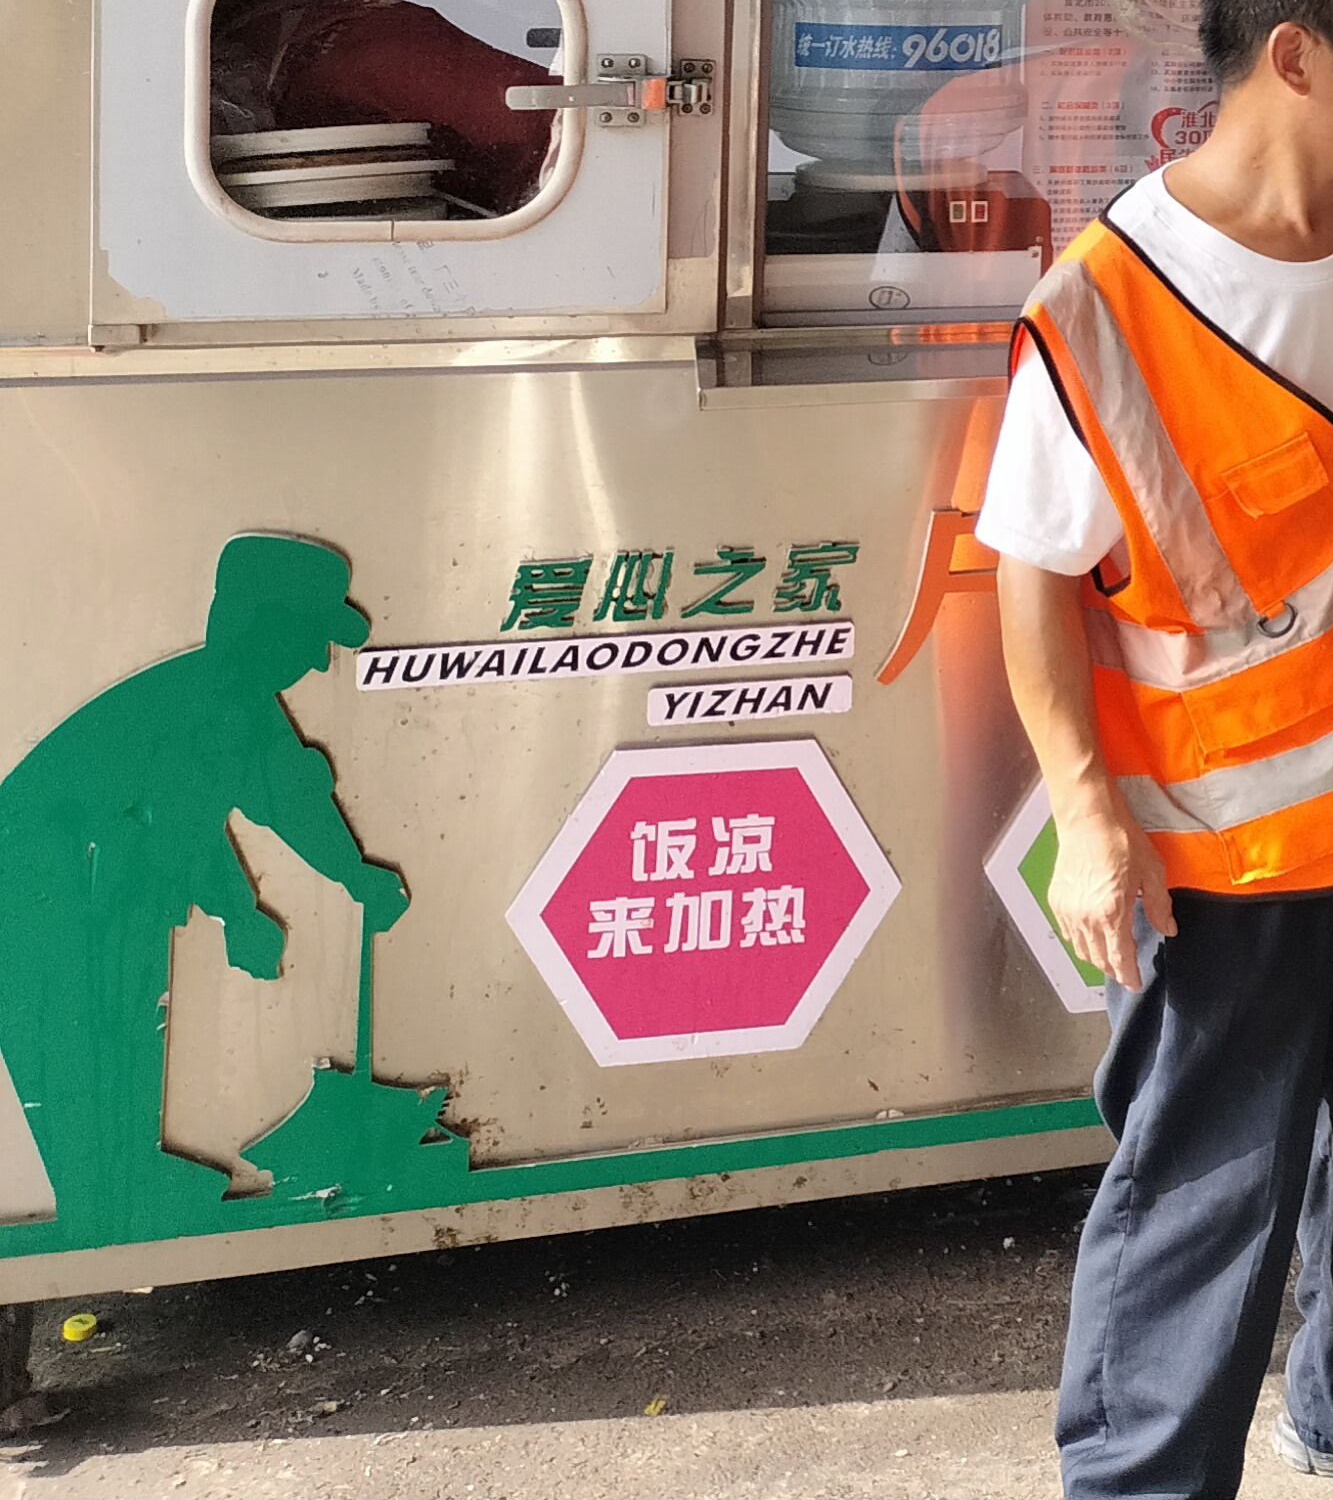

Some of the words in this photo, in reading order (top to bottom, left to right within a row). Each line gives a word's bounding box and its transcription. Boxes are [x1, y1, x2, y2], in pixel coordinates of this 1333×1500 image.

[902, 28, 1000, 68] 96018
[500, 541, 860, 632] 爱心之家
[361, 627, 852, 686] HUWAILAODONGZHE
[662, 682, 834, 721] YIZHAN
[629, 814, 775, 882] 饭凉
[586, 886, 807, 960] 来加热
